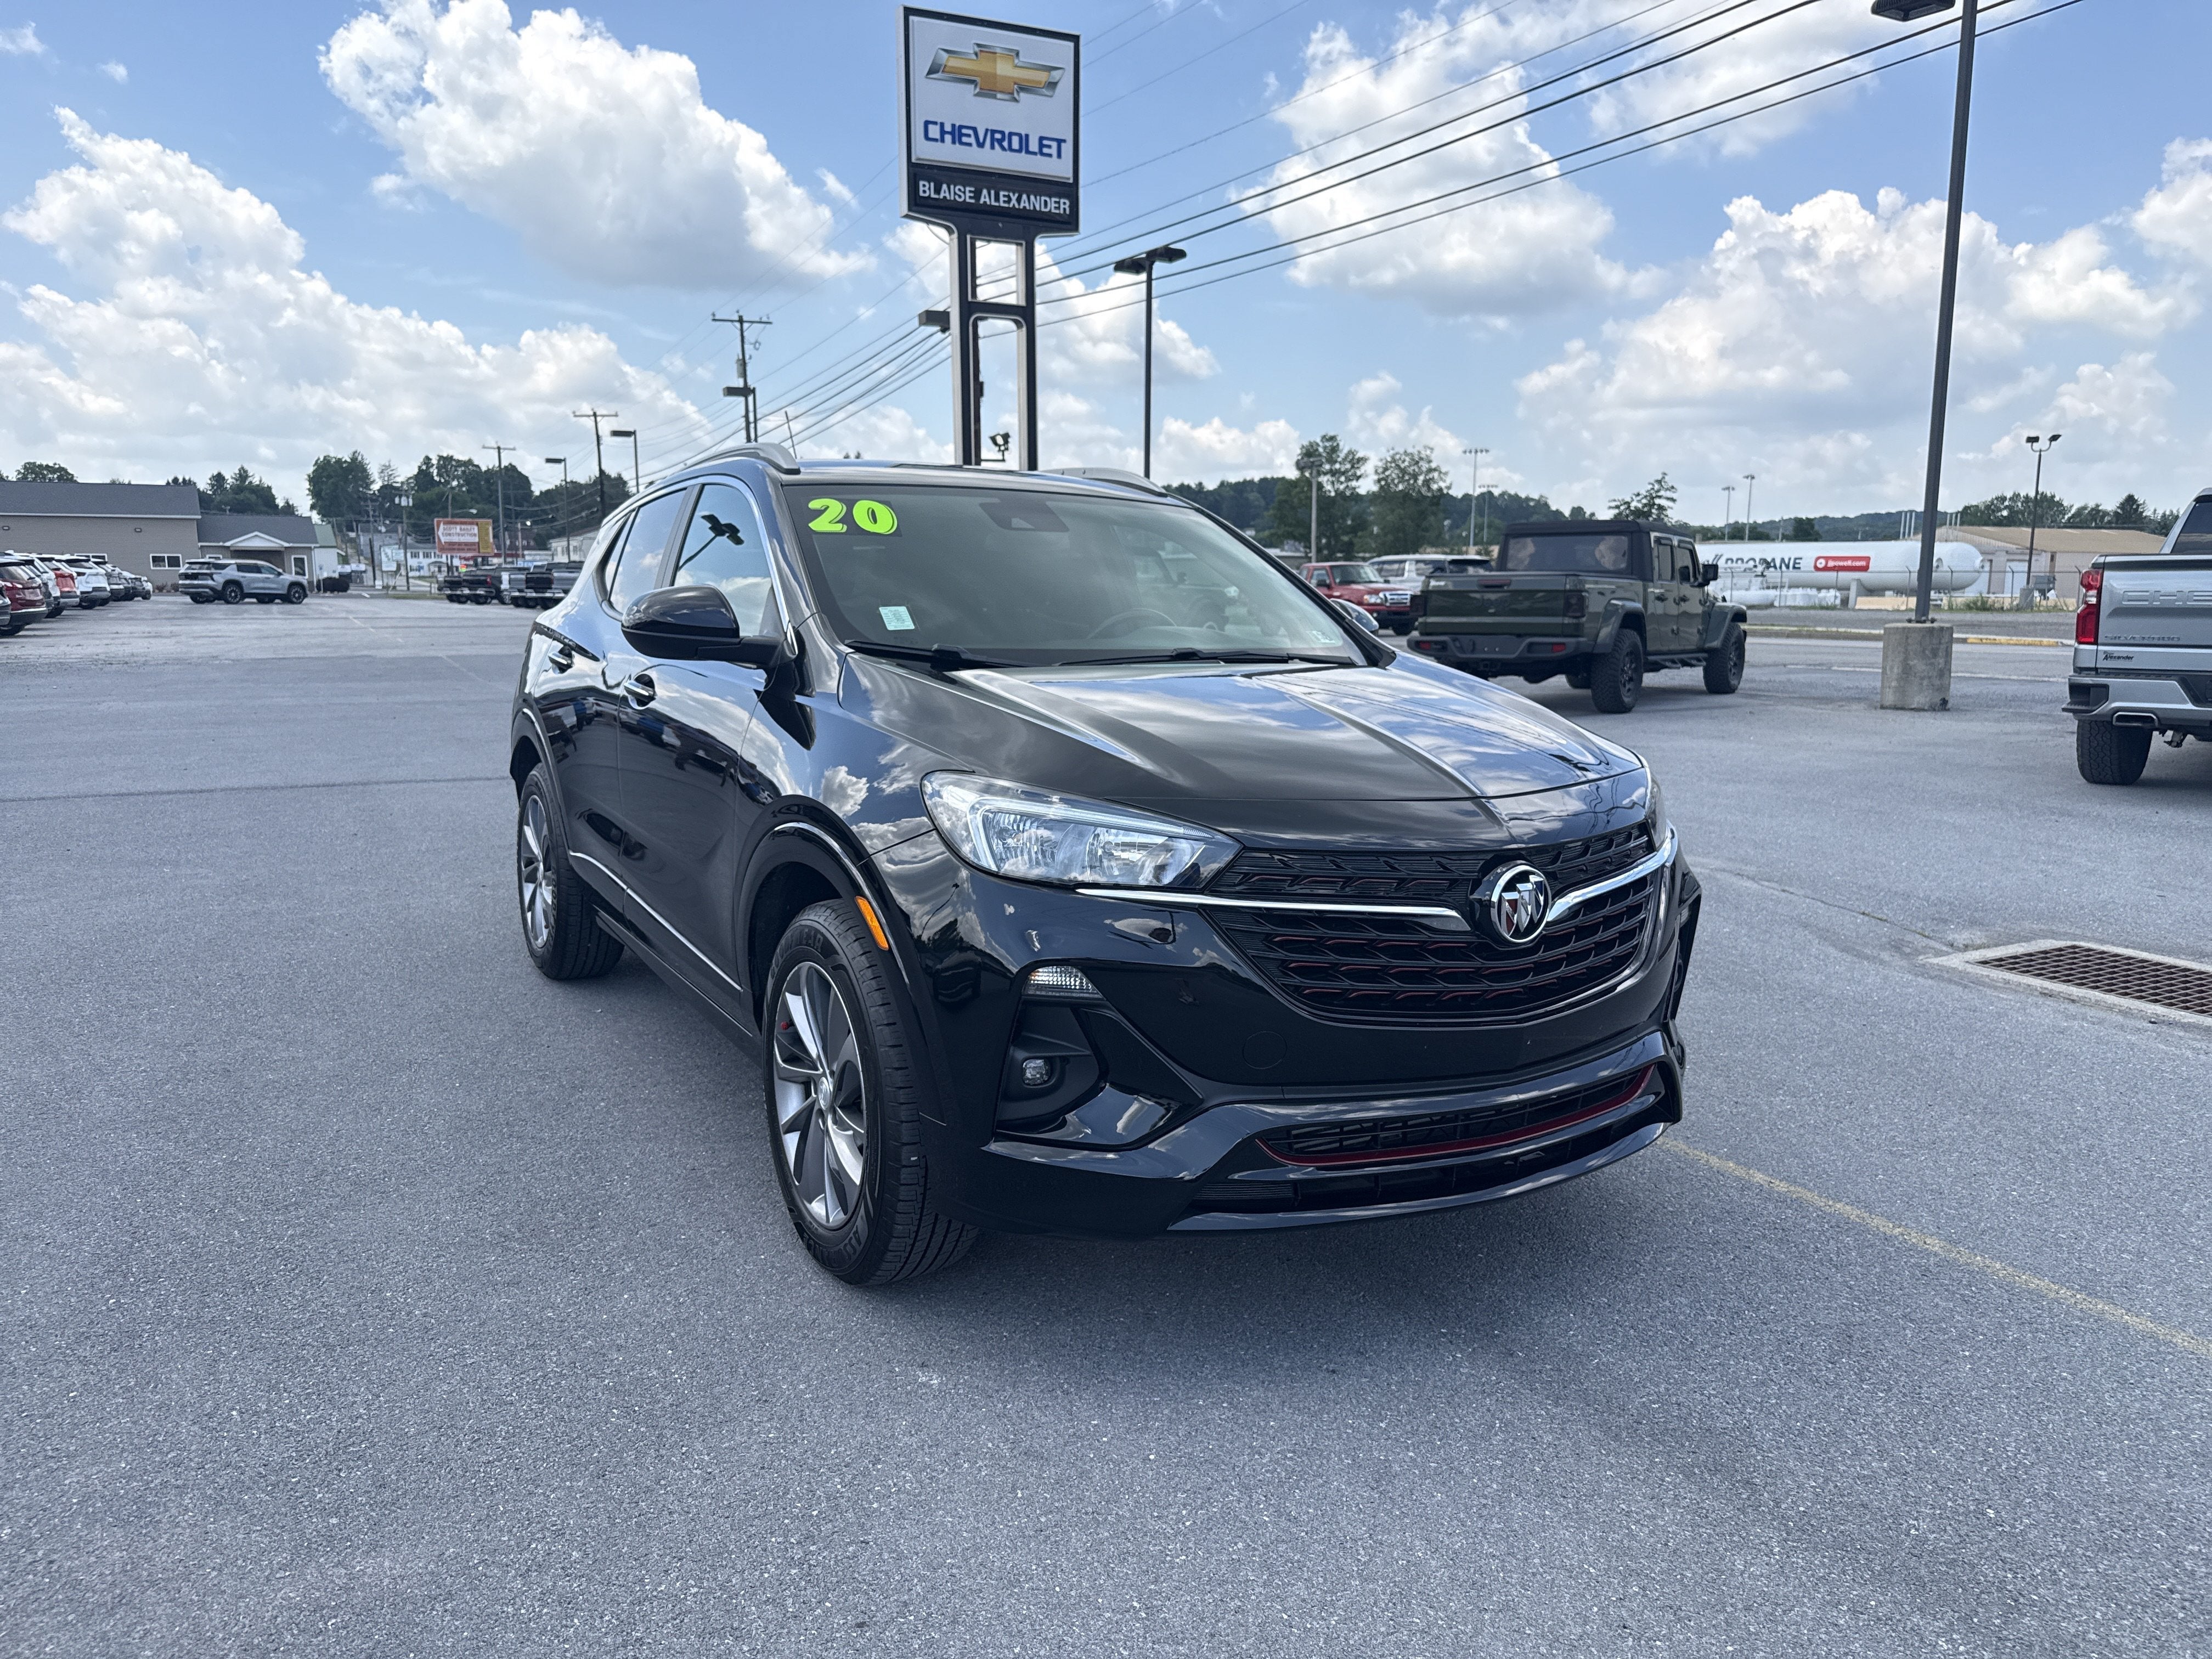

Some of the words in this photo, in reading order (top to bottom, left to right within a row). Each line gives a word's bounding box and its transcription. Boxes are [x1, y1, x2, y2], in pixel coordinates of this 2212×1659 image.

[923, 120, 1066, 159] CHEVROLET
[919, 180, 975, 203] BLAISE
[979, 188, 1070, 215] ALEXANDER
[808, 498, 898, 535] 20
